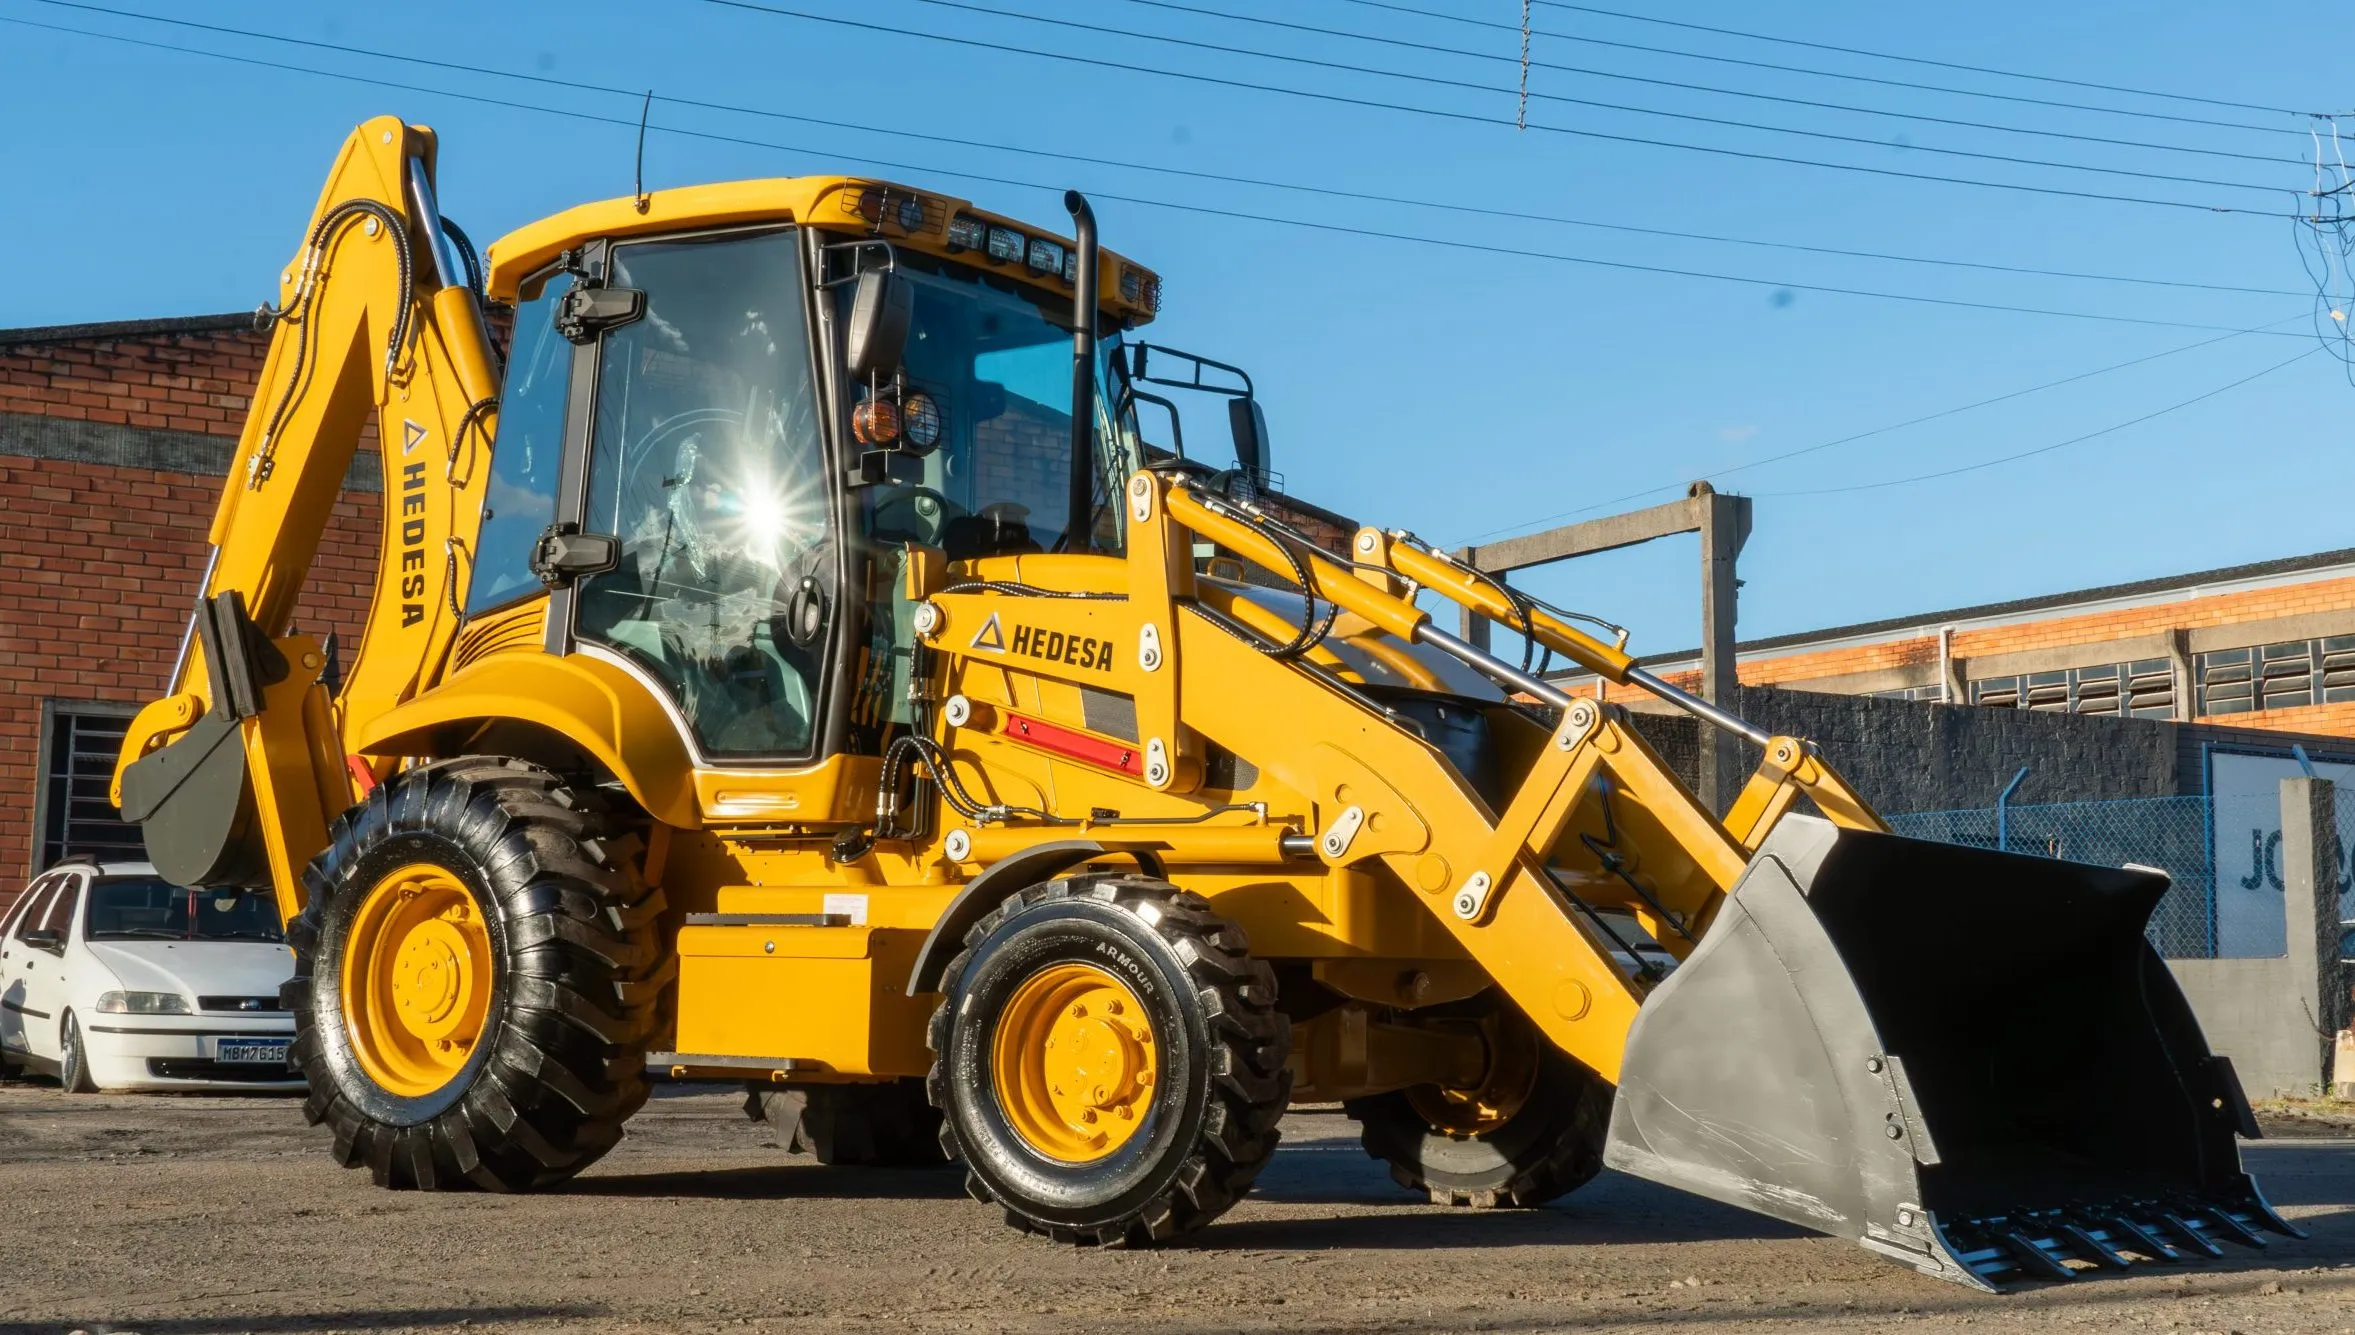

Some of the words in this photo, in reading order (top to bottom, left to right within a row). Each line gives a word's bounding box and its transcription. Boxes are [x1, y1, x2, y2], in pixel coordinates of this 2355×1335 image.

[402, 462, 425, 628] HEDESA
[1012, 624, 1113, 672] HEDESA
[1096, 941, 1154, 995] ARMOUR
